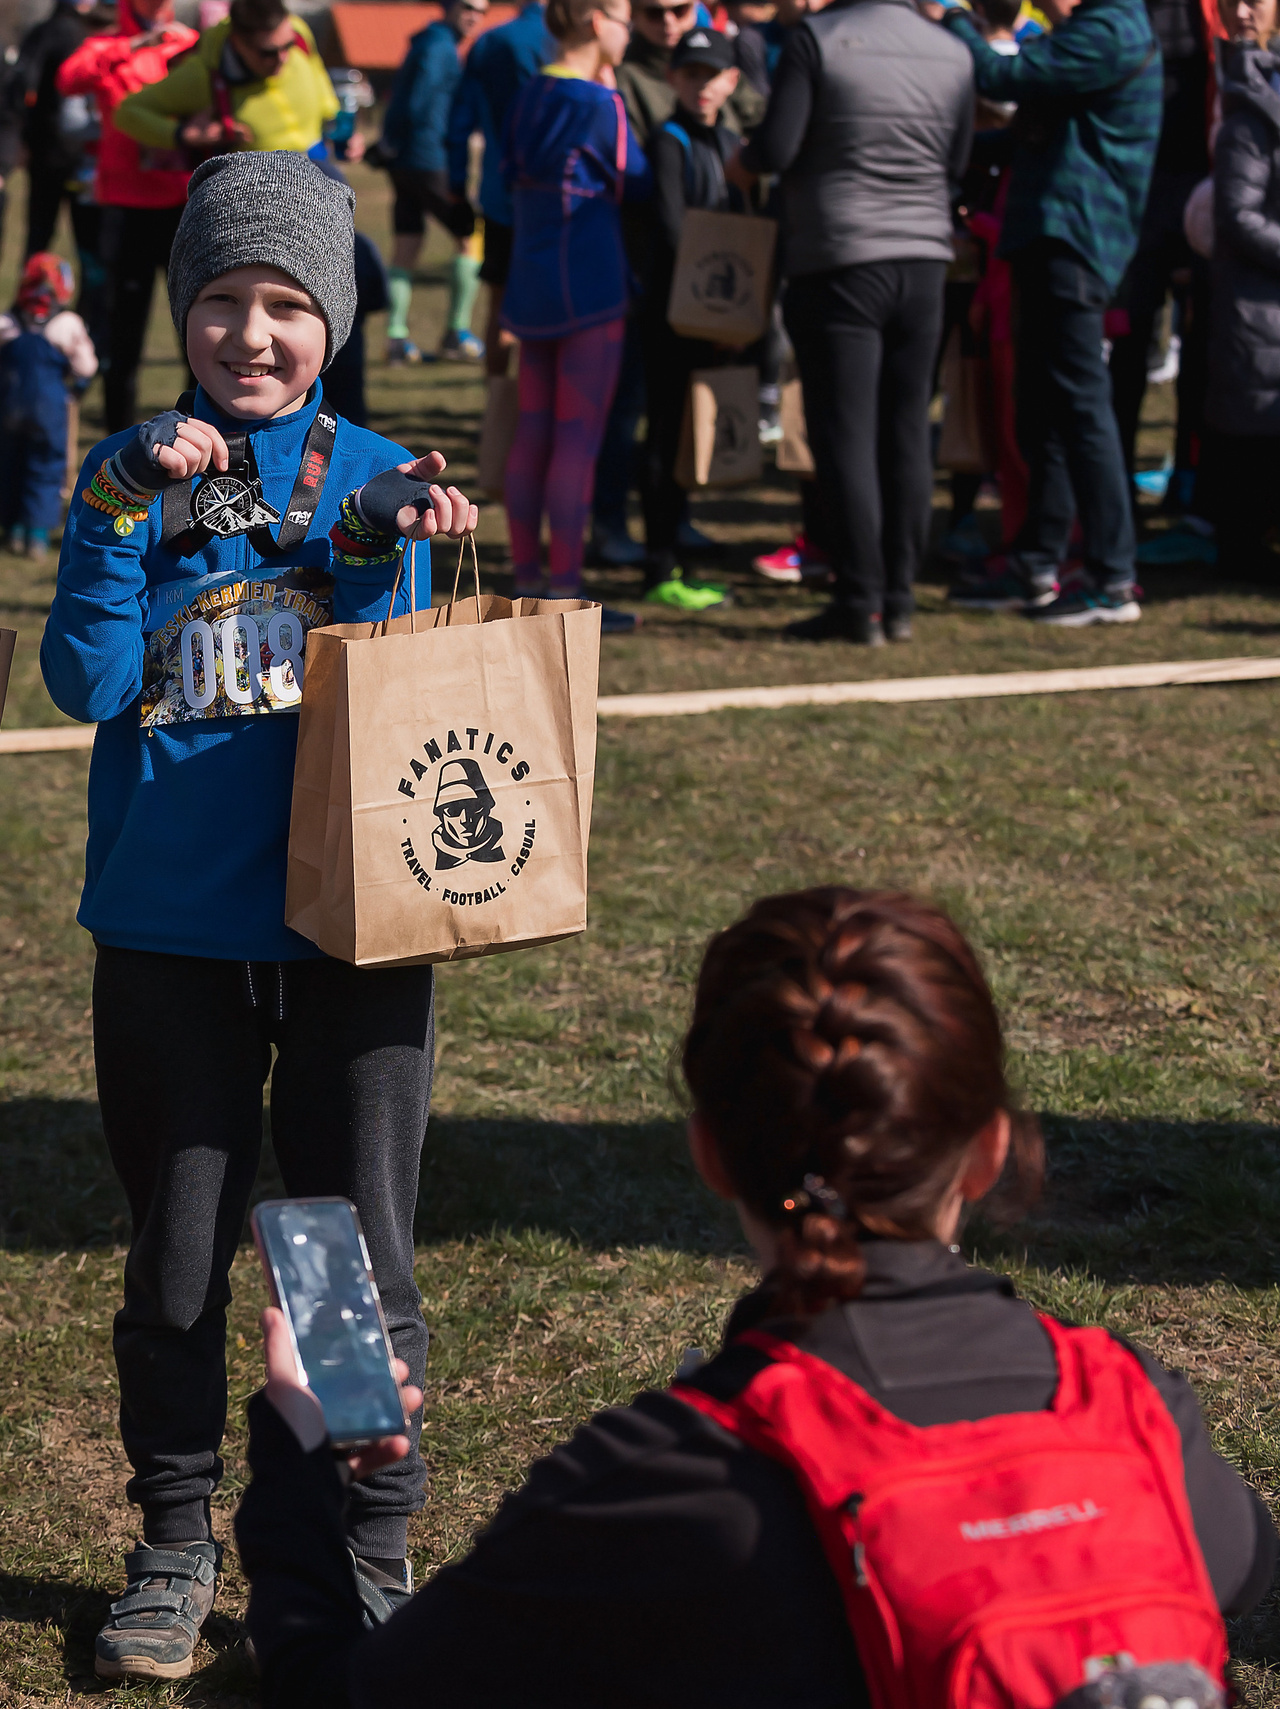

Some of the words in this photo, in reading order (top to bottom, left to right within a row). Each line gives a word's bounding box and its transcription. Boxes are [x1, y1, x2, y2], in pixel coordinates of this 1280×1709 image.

[303, 450, 325, 488] RUN
[157, 580, 277, 646] ESKI-KERMEN
[165, 587, 184, 604] KM
[180, 611, 304, 709] 008
[397, 727, 531, 799] FANATICS
[401, 837, 433, 892] TRAVEL
[441, 881, 507, 906] FOOTBALL
[510, 818, 536, 876] CASUAL
